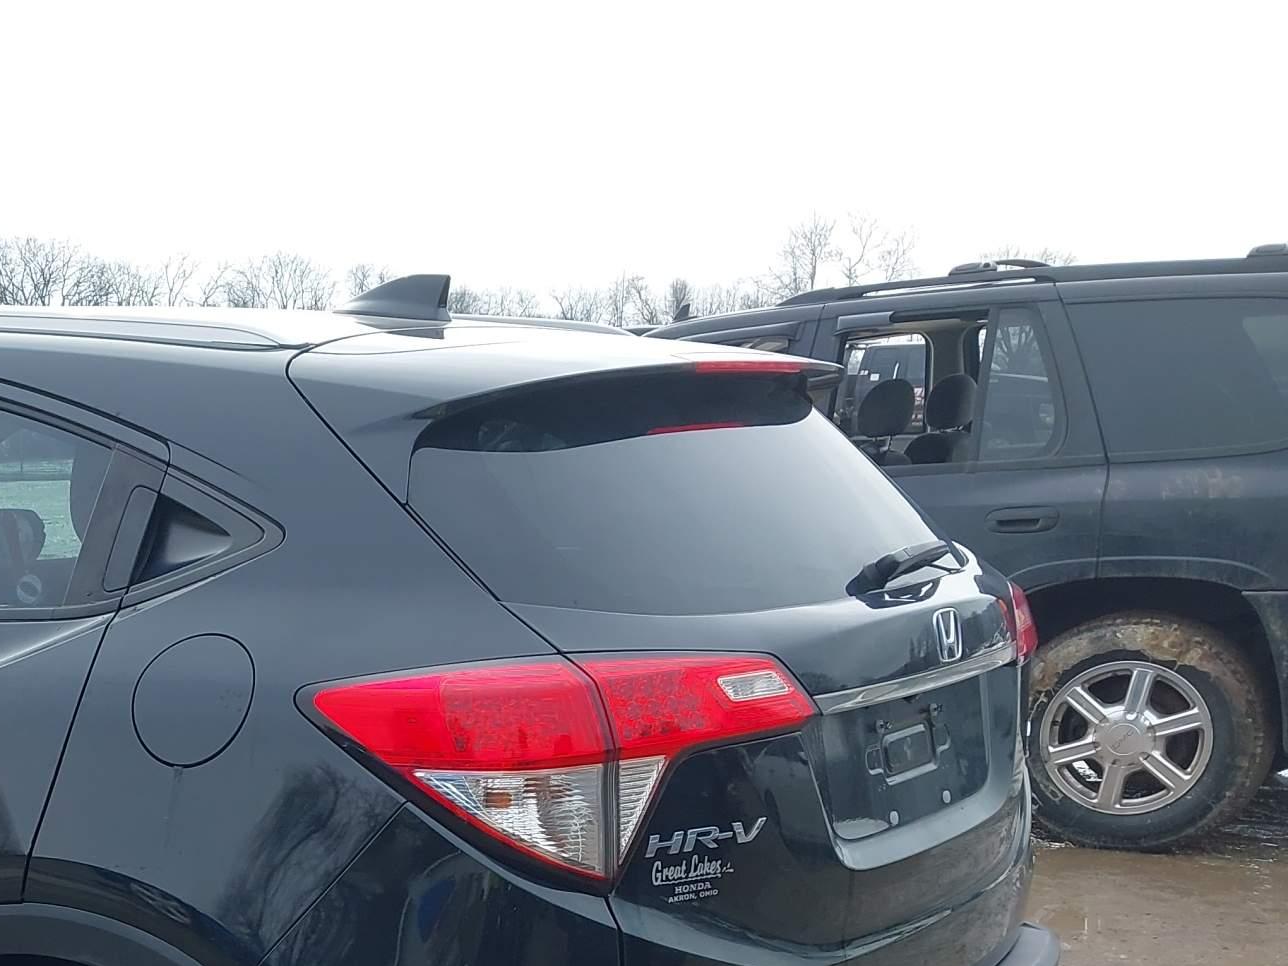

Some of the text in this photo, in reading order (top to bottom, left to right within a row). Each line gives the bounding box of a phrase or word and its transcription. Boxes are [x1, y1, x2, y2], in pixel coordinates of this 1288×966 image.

[645, 817, 767, 858] HR-V
[652, 855, 722, 886] Great Lakes
[675, 881, 711, 894] HONDA
[699, 889, 719, 898] OHIO
